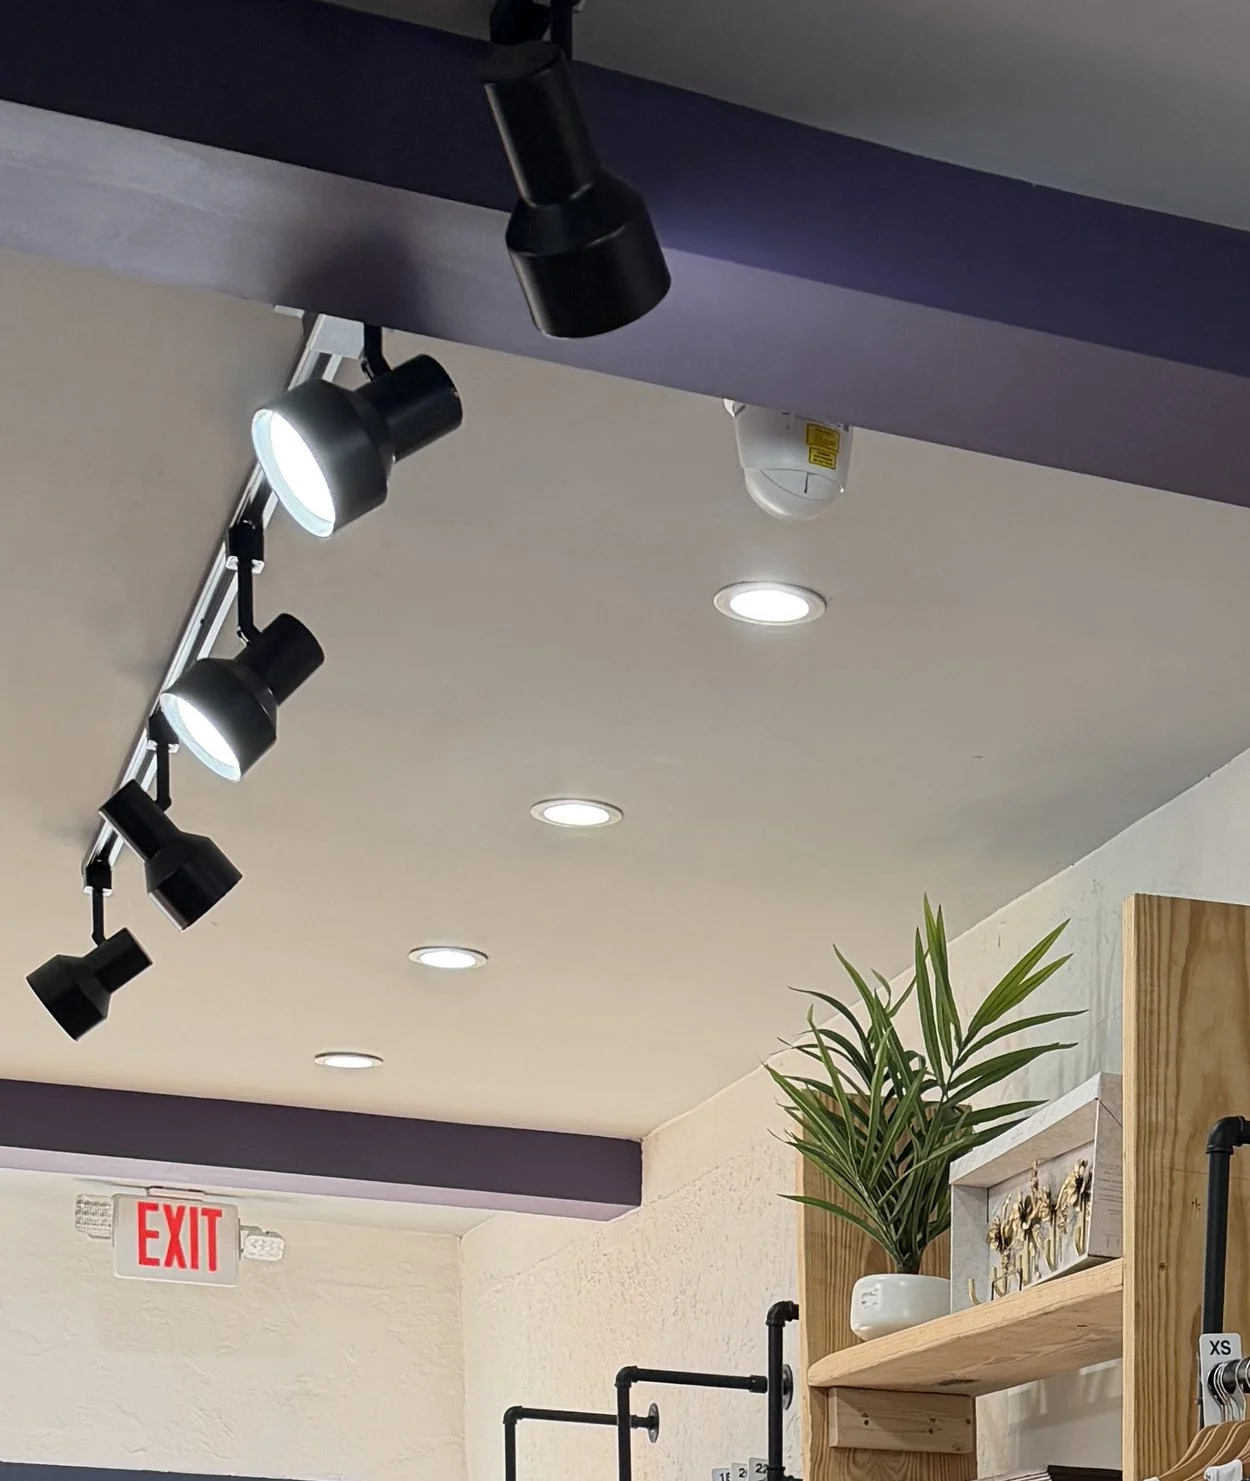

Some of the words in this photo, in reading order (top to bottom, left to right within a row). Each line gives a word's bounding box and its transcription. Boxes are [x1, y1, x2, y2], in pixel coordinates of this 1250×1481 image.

[137, 1201, 222, 1272] EXIT
[1209, 1340, 1231, 1355] XS
[739, 1468, 747, 1478] 2
